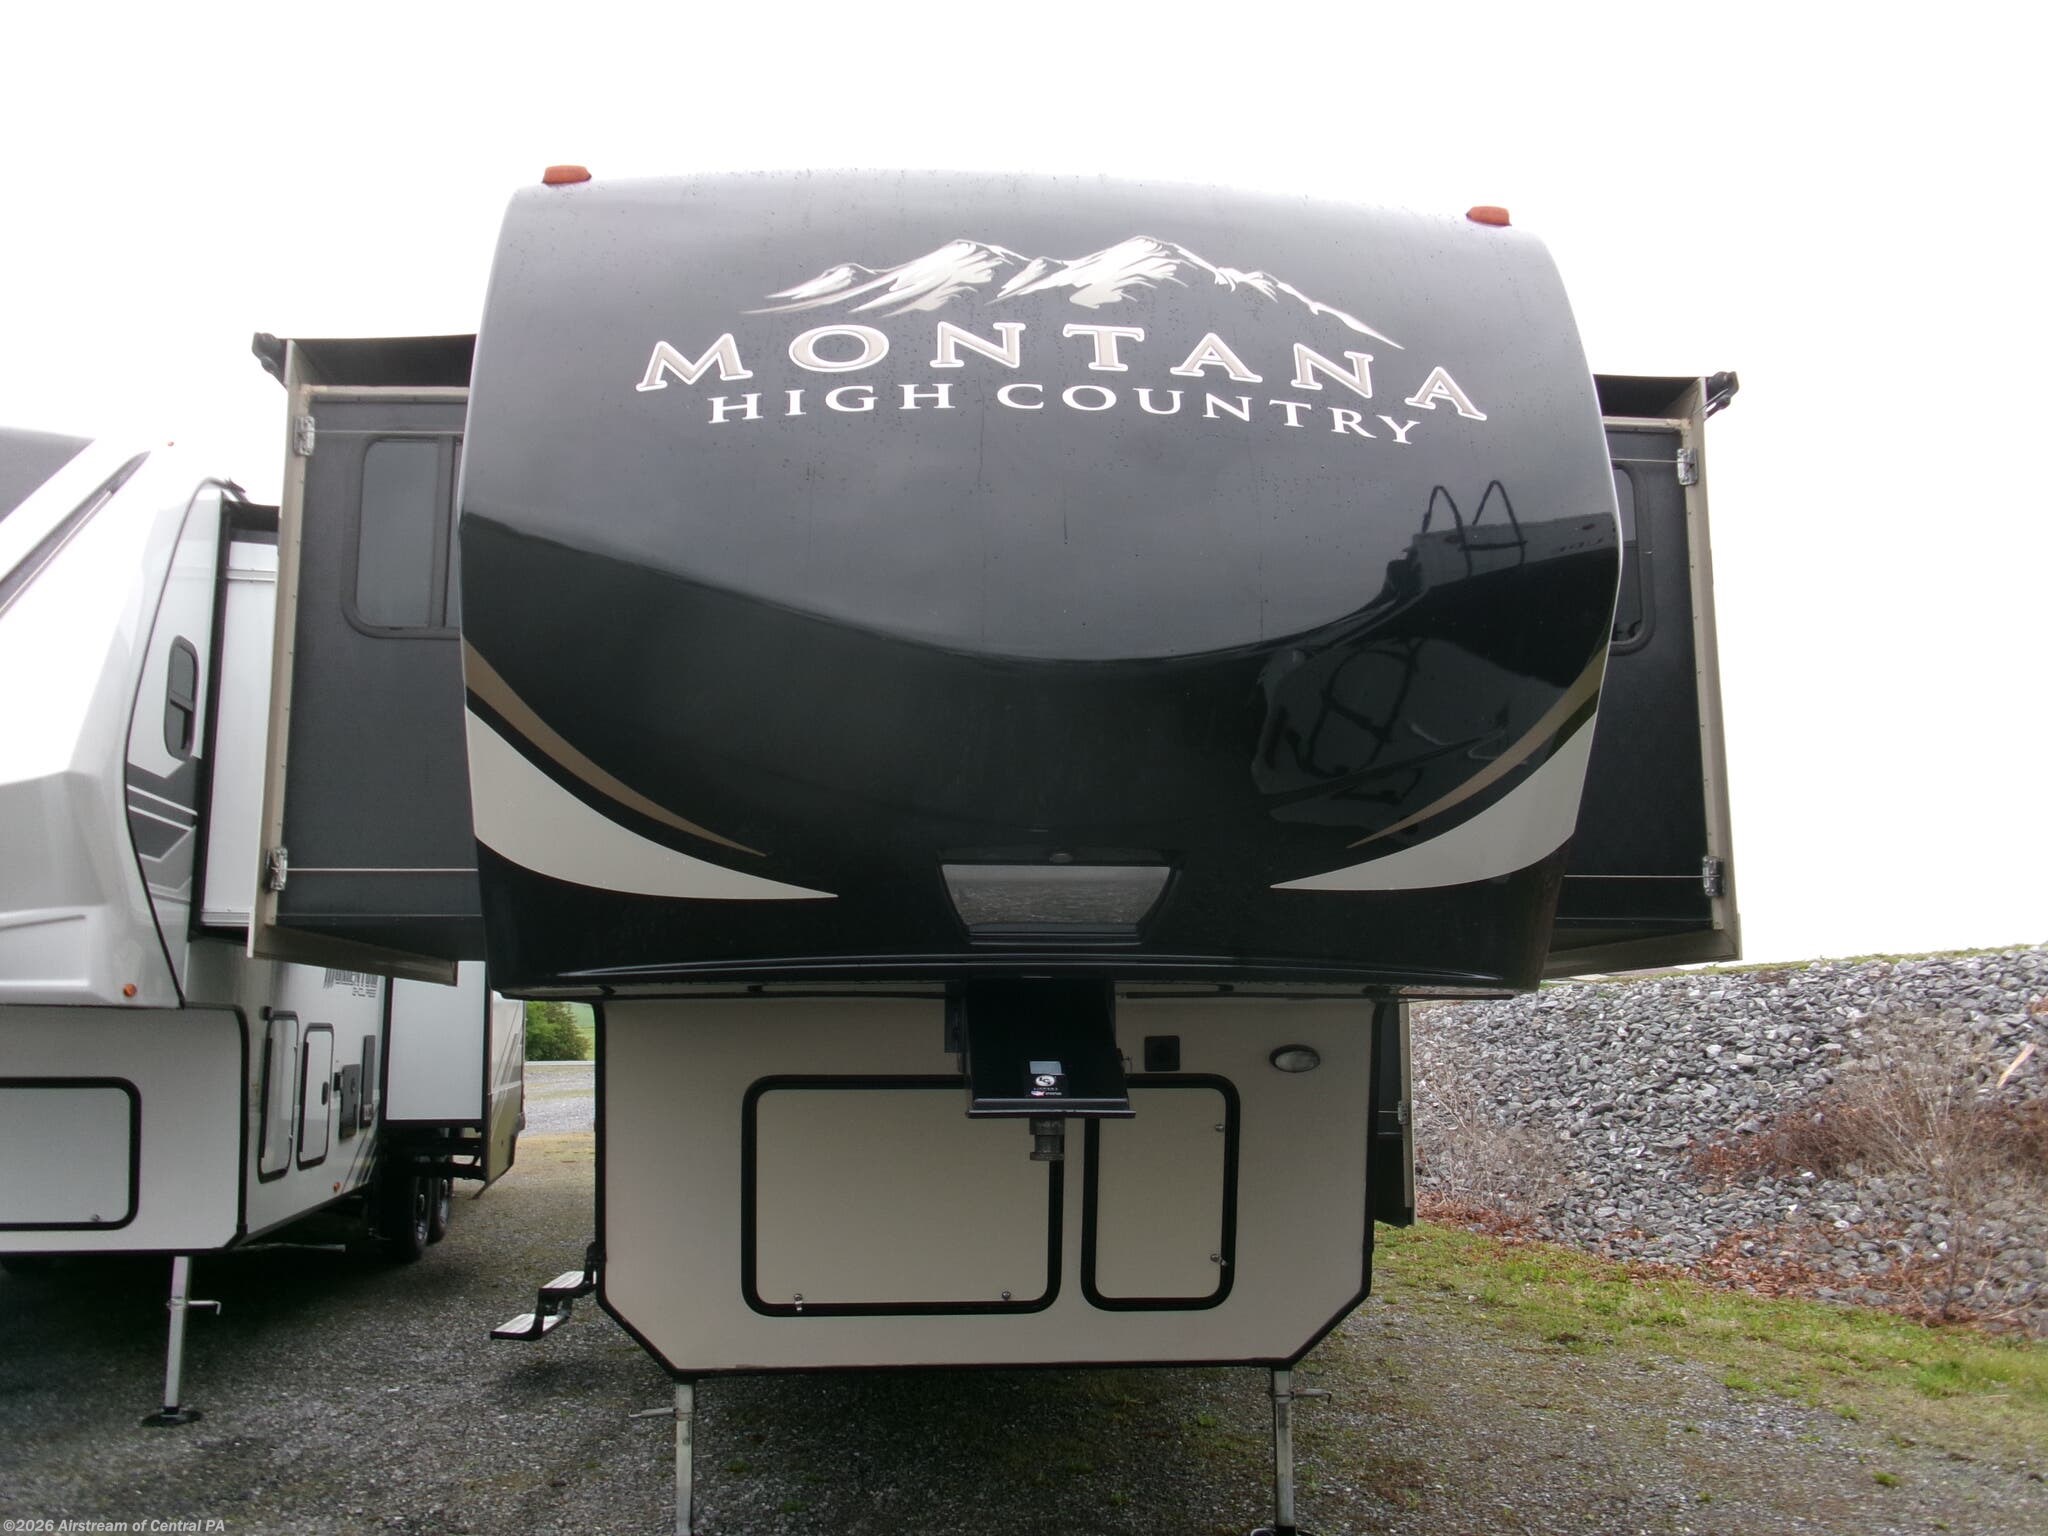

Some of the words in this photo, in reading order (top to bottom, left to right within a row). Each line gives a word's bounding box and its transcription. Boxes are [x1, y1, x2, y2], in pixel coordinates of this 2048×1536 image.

[635, 320, 1489, 422] MONTANA
[707, 382, 956, 424] HIGH
[996, 384, 1421, 445] COUNTRY
